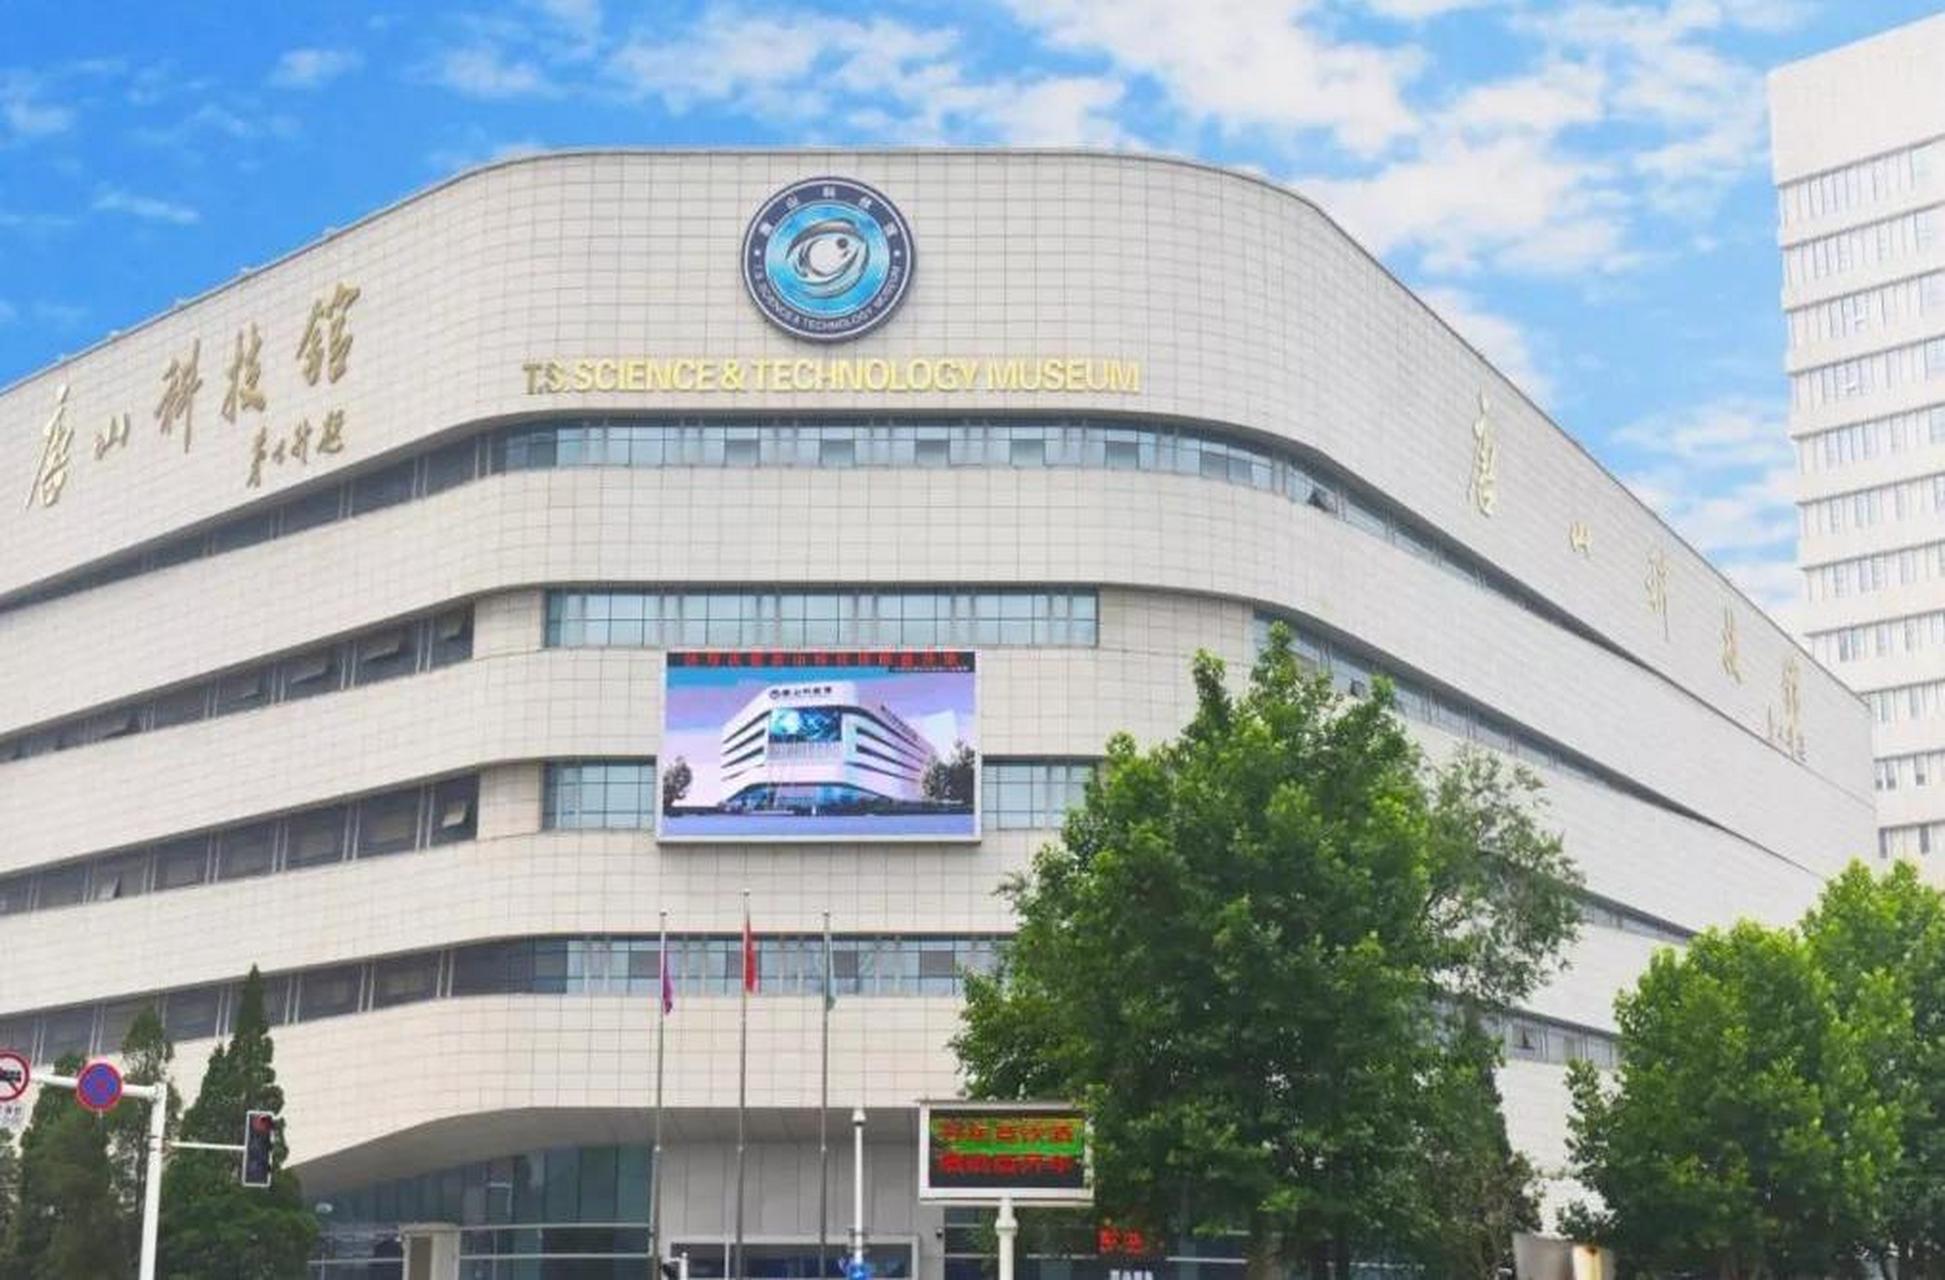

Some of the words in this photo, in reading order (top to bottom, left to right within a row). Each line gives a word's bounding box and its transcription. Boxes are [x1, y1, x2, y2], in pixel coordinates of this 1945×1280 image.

[719, 359, 748, 393] &
[751, 358, 978, 393] TECHNOLOGY
[985, 358, 1141, 395] MUSEUM
